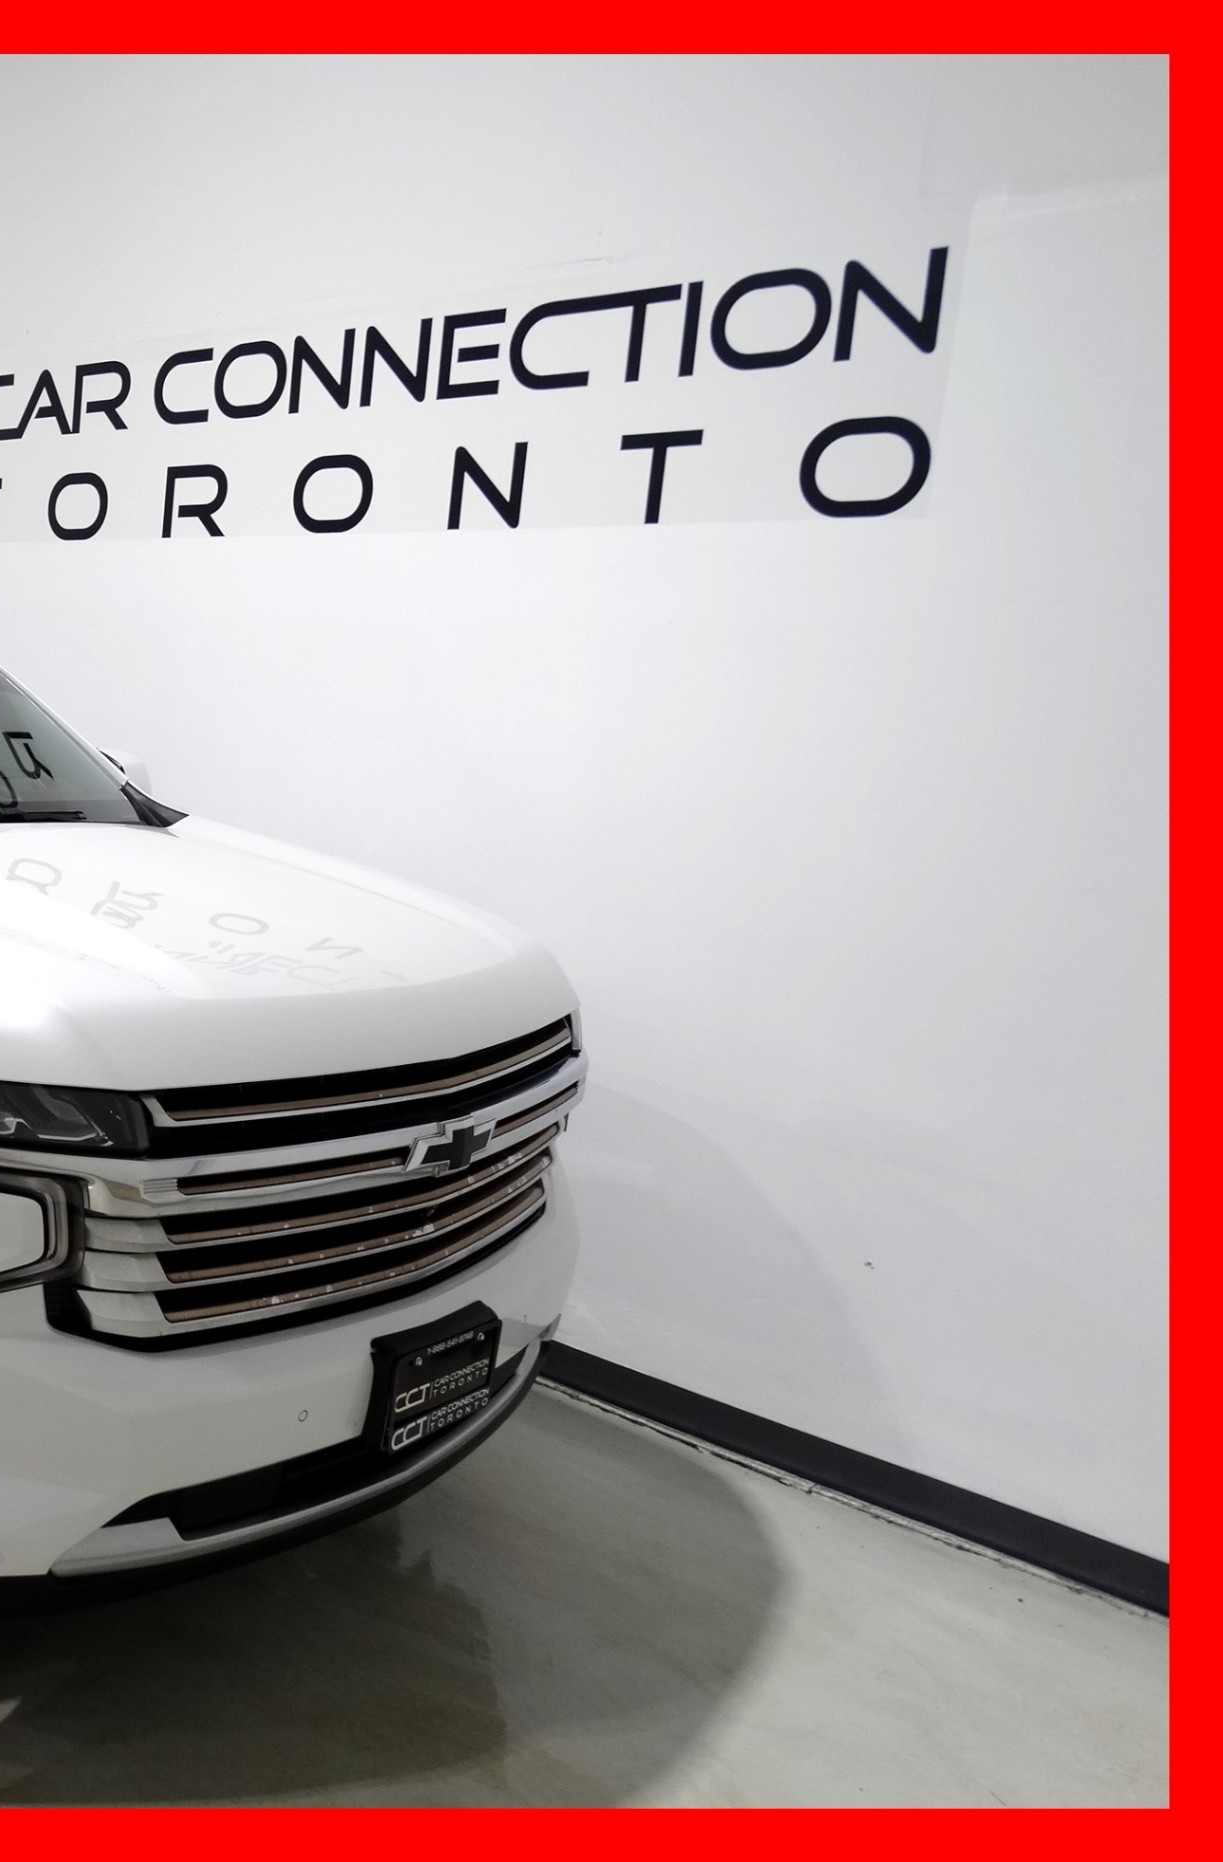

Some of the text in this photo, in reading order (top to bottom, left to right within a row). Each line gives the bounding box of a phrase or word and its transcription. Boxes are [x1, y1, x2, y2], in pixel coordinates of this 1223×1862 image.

[154, 246, 949, 425] CONNECTION
[433, 1367, 488, 1397] TORONTO
[434, 1358, 490, 1387] CAR CONNECTION
[394, 1383, 431, 1413] CCT
[430, 1397, 488, 1431] TORONTO
[431, 1388, 490, 1420] CAR CONNECTION
[391, 1416, 427, 1450] CCT
